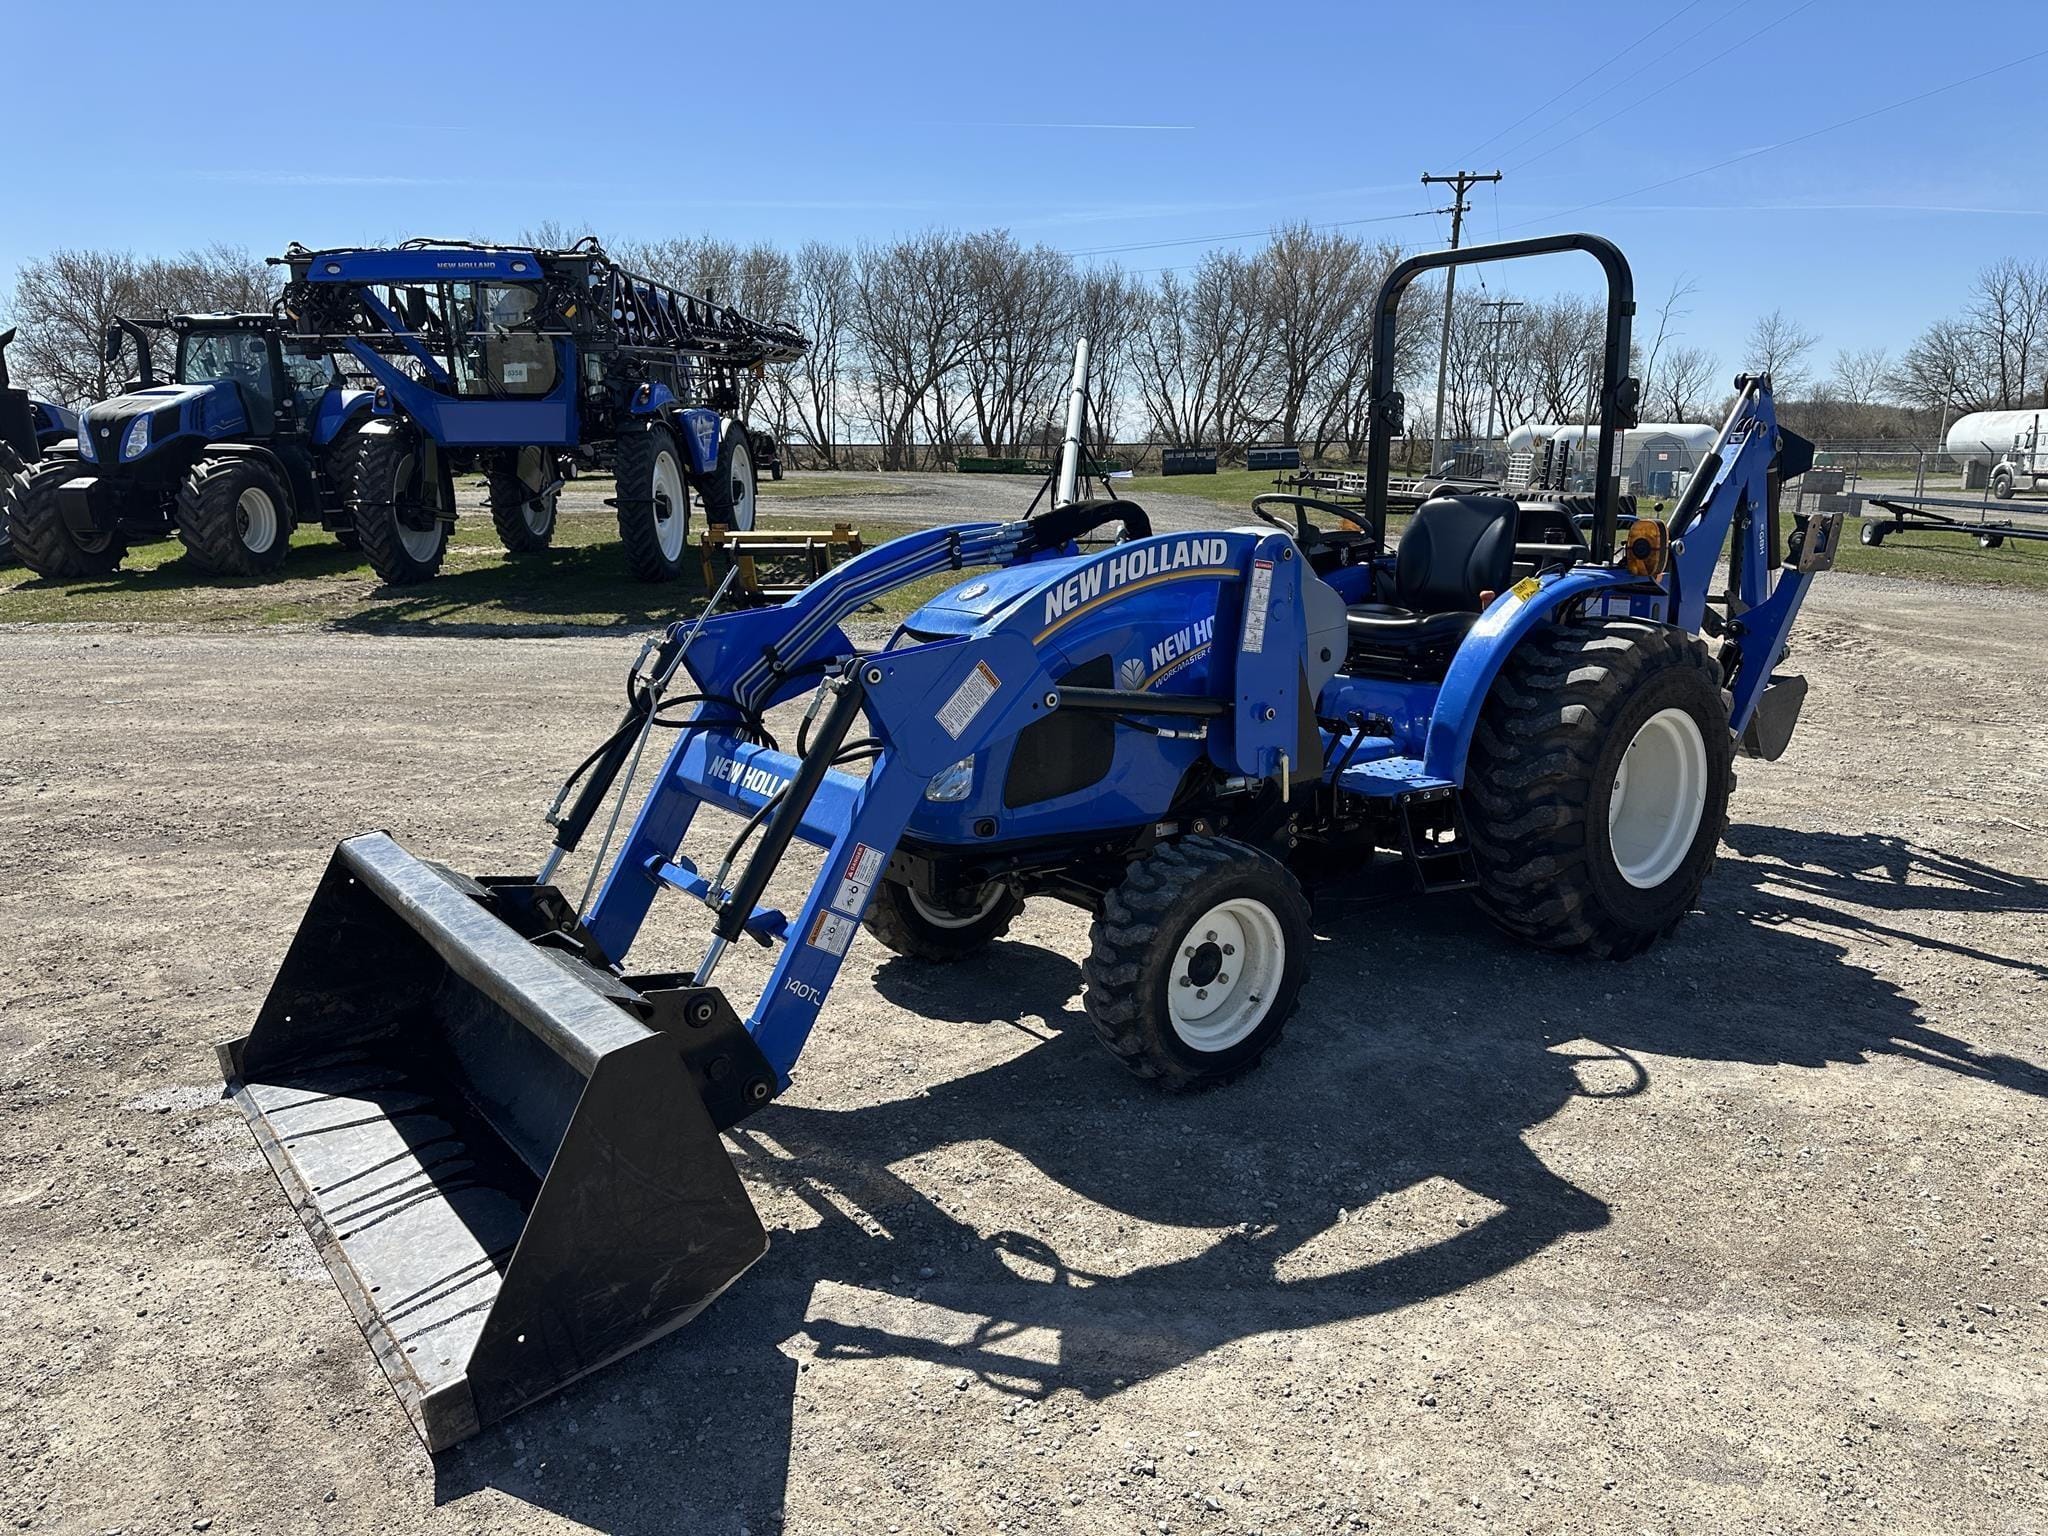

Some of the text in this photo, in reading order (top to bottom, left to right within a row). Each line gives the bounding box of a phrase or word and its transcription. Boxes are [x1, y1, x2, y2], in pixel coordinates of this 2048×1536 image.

[1044, 538, 1228, 626] NEW HOLLAND
[1150, 626, 1191, 672] NEW
[1155, 649, 1206, 688] WORKMASTER
[708, 755, 746, 784] NEW
